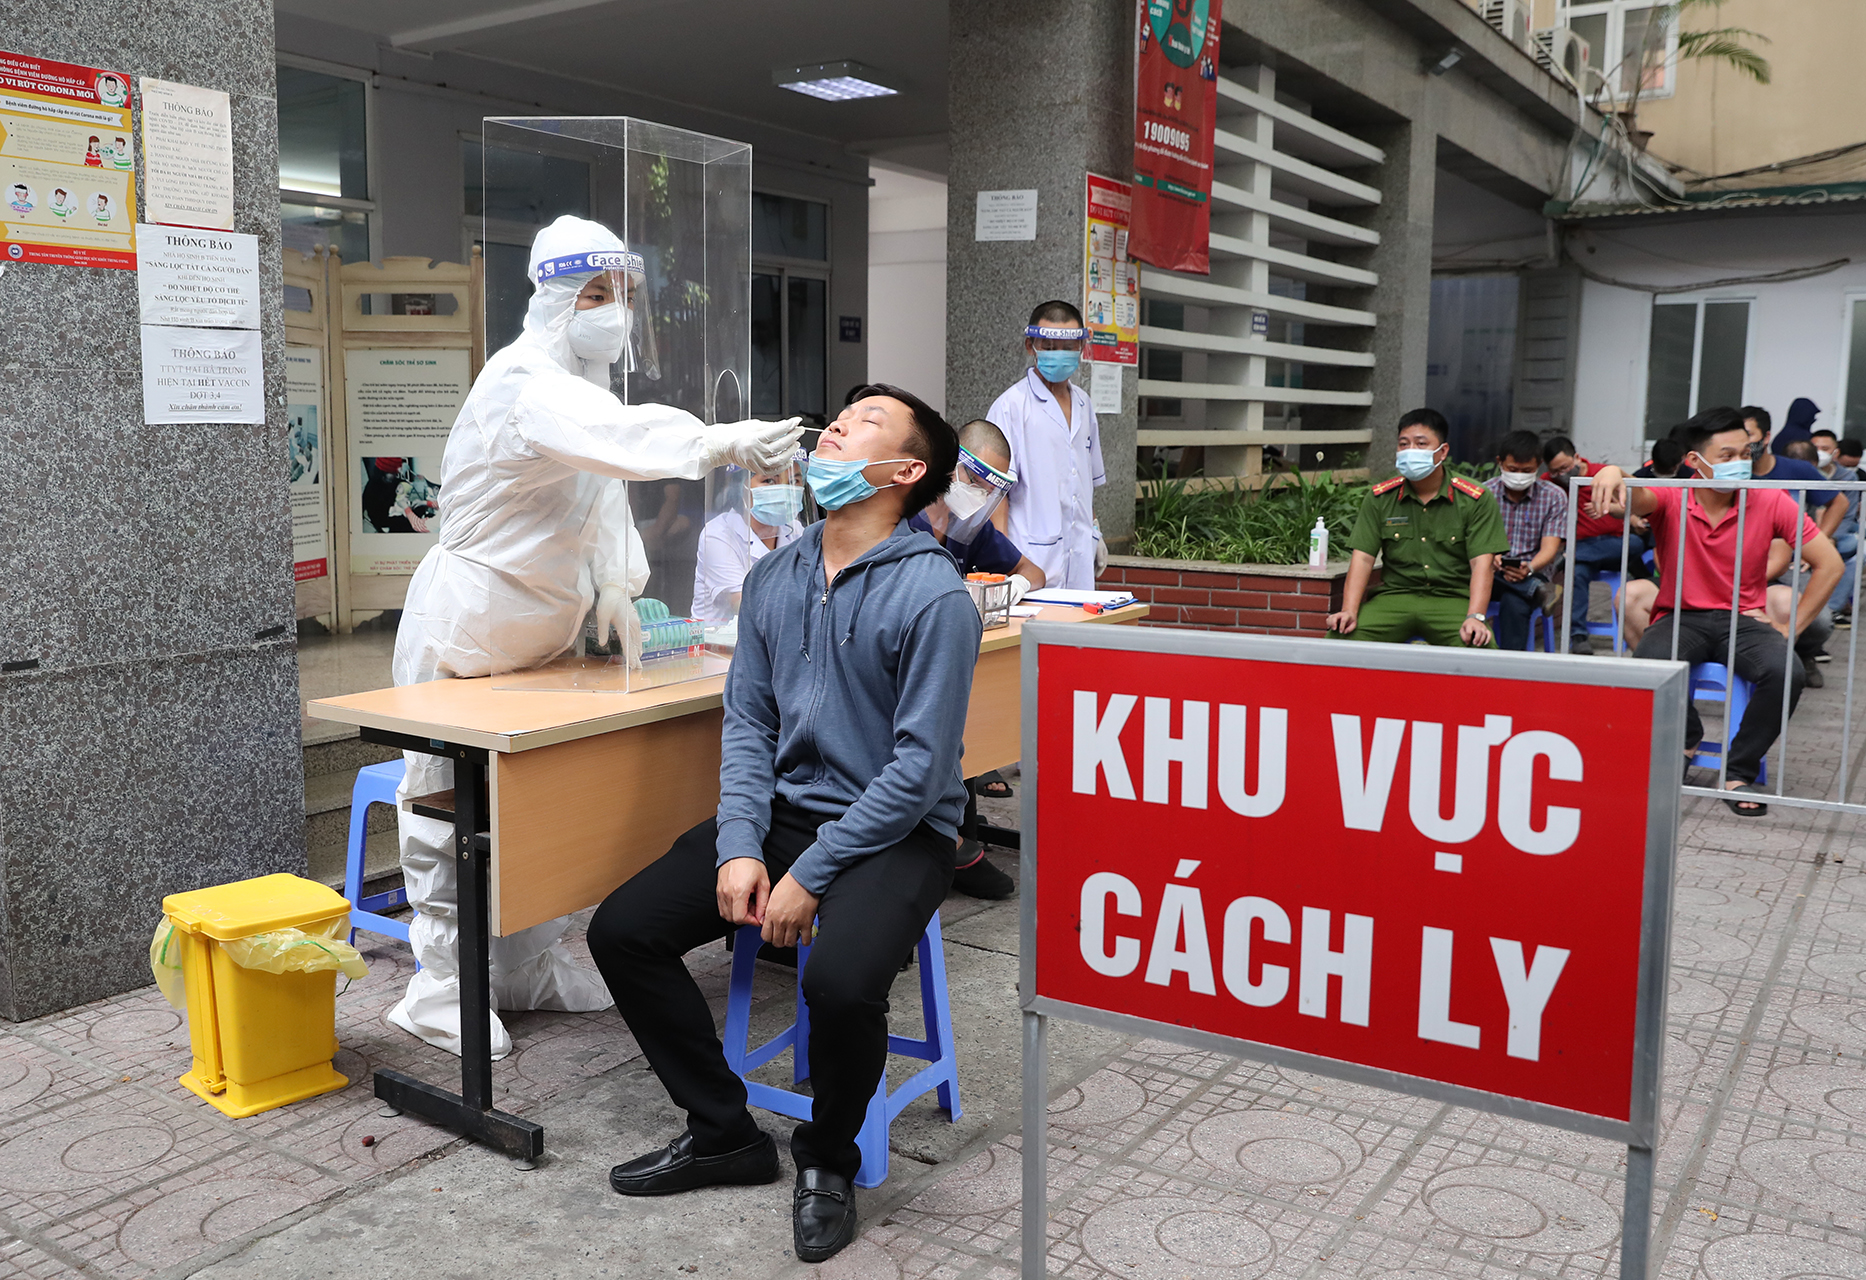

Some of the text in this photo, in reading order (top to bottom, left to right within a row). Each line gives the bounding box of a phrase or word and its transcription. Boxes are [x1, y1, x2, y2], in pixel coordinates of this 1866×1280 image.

[5, 78, 16, 86] VI
[17, 80, 37, 90] RÚT
[37, 83, 76, 96] CORONA
[163, 101, 193, 115] THÔNG
[1144, 120, 1190, 152] 19009095
[165, 234, 233, 251] THÔNG BÁO
[170, 262, 185, 270] LỌC
[592, 254, 621, 266] Face
[1060, 329, 1082, 337] Shield
[172, 346, 236, 360] THÔNG BÁO
[158, 377, 250, 388] HIỆN TẠI HẾT VACCIN
[1072, 689, 1584, 873] KHU VỰC
[1079, 858, 1571, 1061] CÁCH LY
